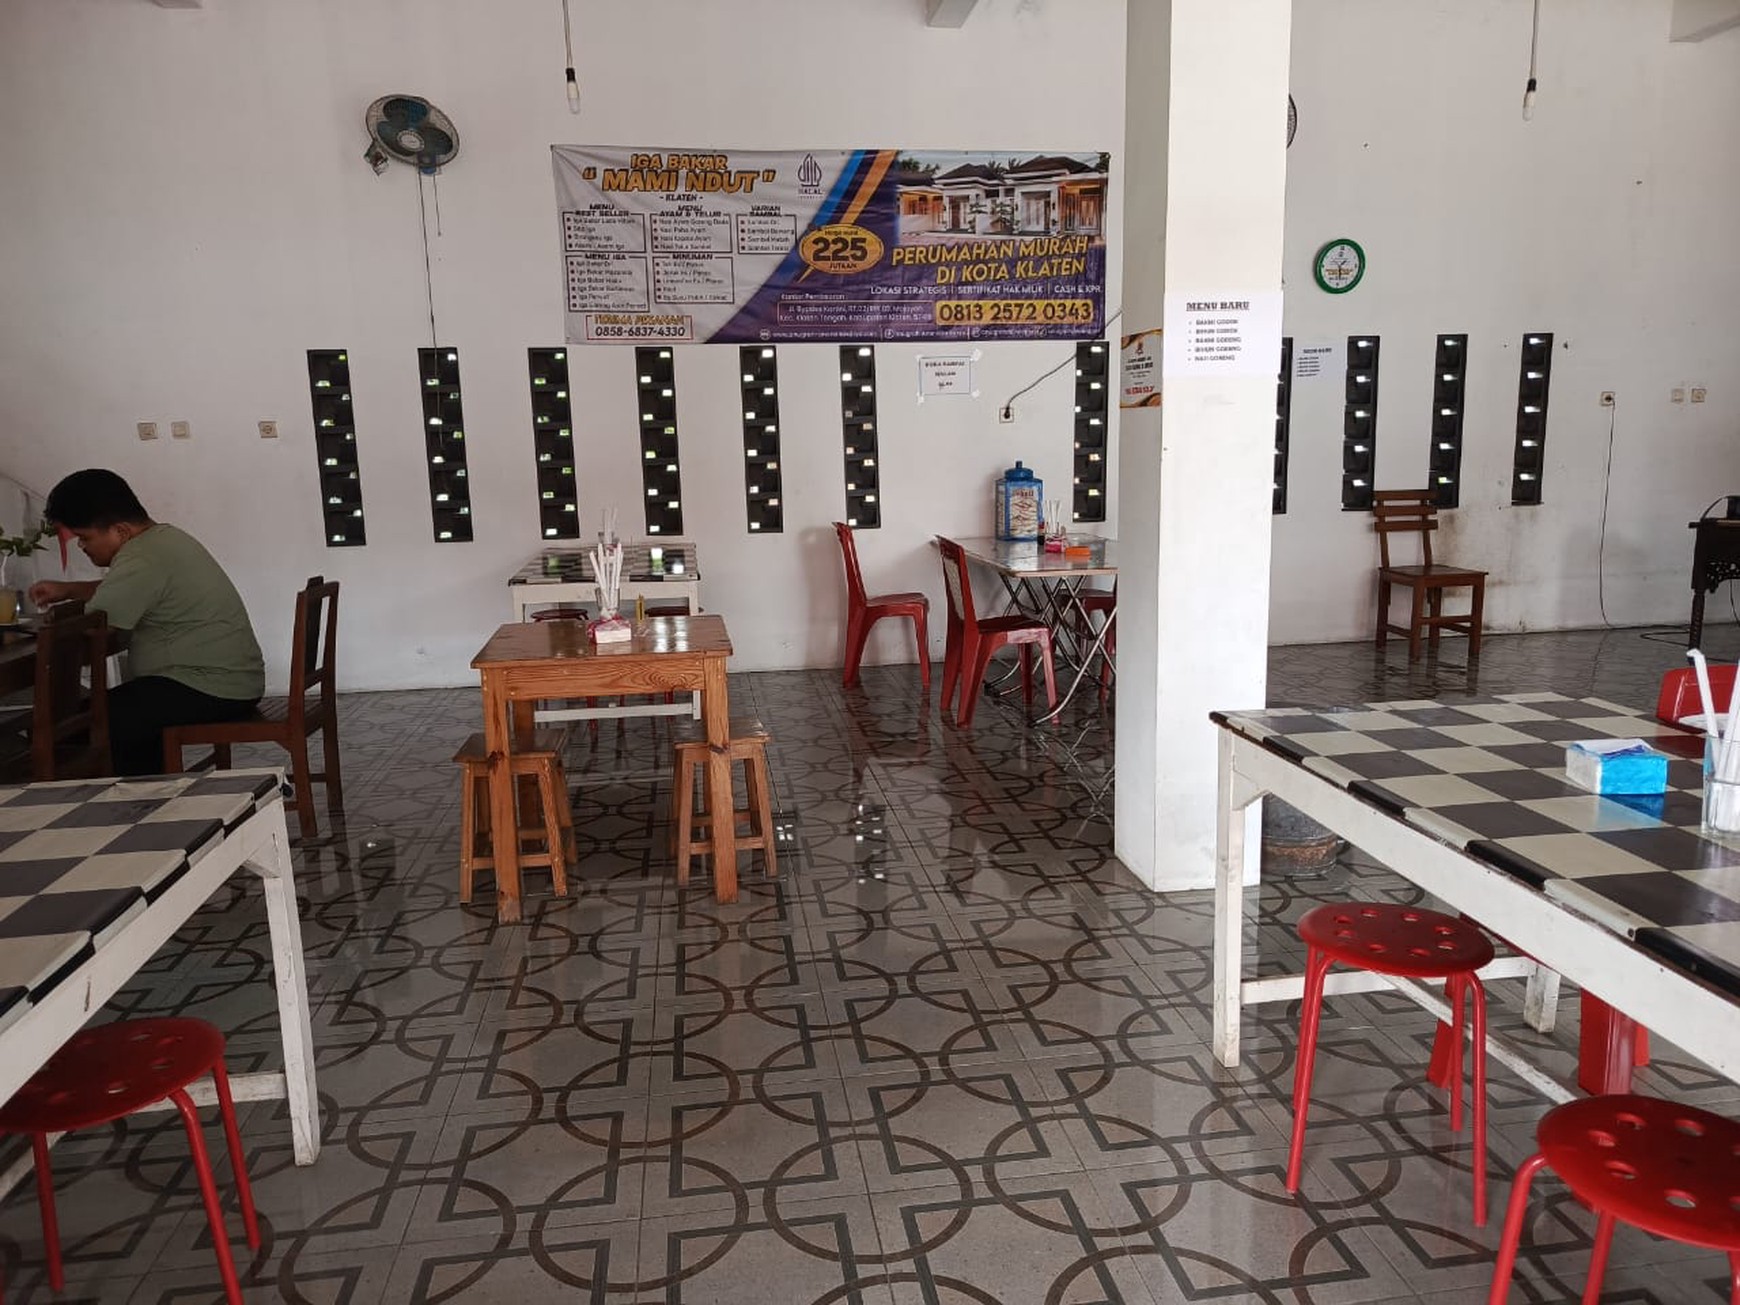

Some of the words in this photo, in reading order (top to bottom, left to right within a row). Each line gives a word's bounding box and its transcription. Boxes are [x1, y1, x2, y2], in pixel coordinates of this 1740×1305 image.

[630, 153, 662, 169] IGA
[668, 154, 728, 171] BAKAR
[602, 169, 678, 192] MAMI
[685, 170, 759, 194] NDUT
[812, 236, 868, 262] 225
[891, 239, 1015, 267] PERUMAHAN
[1019, 235, 1089, 257] MURAH
[936, 265, 956, 285] DI
[961, 262, 1010, 283] KOTA
[1016, 257, 1086, 279] KLATEN
[870, 286, 901, 295] LOKASI
[903, 286, 947, 295] STRATEGIS
[957, 285, 1001, 294] SERTIFIKAT
[1003, 285, 1021, 294] HAK
[1021, 285, 1043, 294] MILIK
[1054, 285, 1076, 293] CASH
[1085, 285, 1101, 293] KPR
[940, 302, 984, 321] 0813
[990, 302, 1037, 321] 2572
[1043, 302, 1092, 320] 0343
[1186, 302, 1218, 311] MENU
[1220, 301, 1250, 310] BARU
[595, 326, 686, 337] 0858-6837-4330
